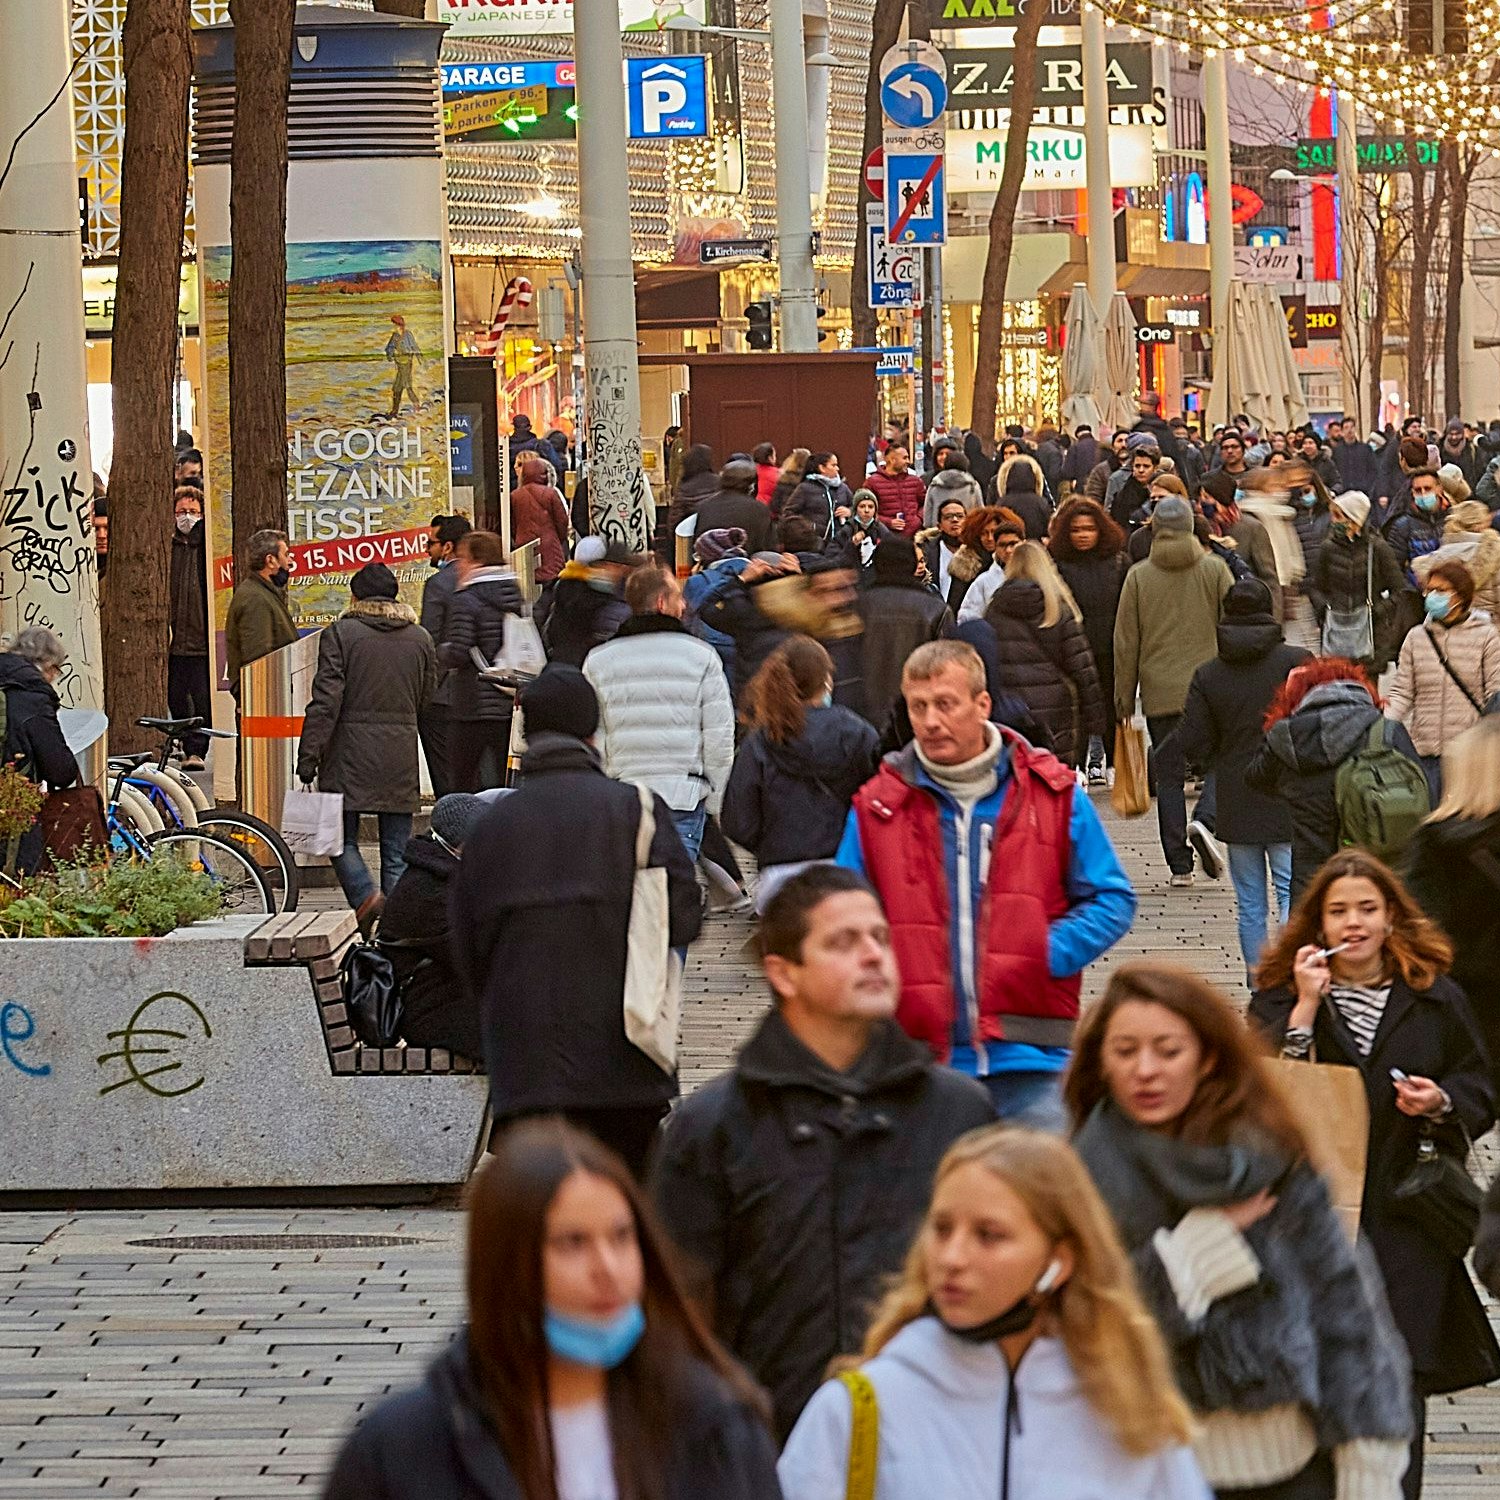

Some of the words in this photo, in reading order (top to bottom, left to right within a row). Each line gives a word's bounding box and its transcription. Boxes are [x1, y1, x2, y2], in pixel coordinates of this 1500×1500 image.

[441, 12, 461, 22] SY
[468, 10, 556, 21] JAPANESE
[440, 66, 525, 86] GARAGE
[952, 58, 1139, 95] ZARA
[976, 138, 1083, 164] MRKU
[976, 170, 997, 180] Ih
[1034, 169, 1077, 179] Mar
[868, 208, 884, 217] ausg
[313, 426, 422, 462] GOGH
[288, 463, 432, 502] ÉZANNE
[288, 507, 384, 541] TISSE
[303, 548, 333, 570] 15.
